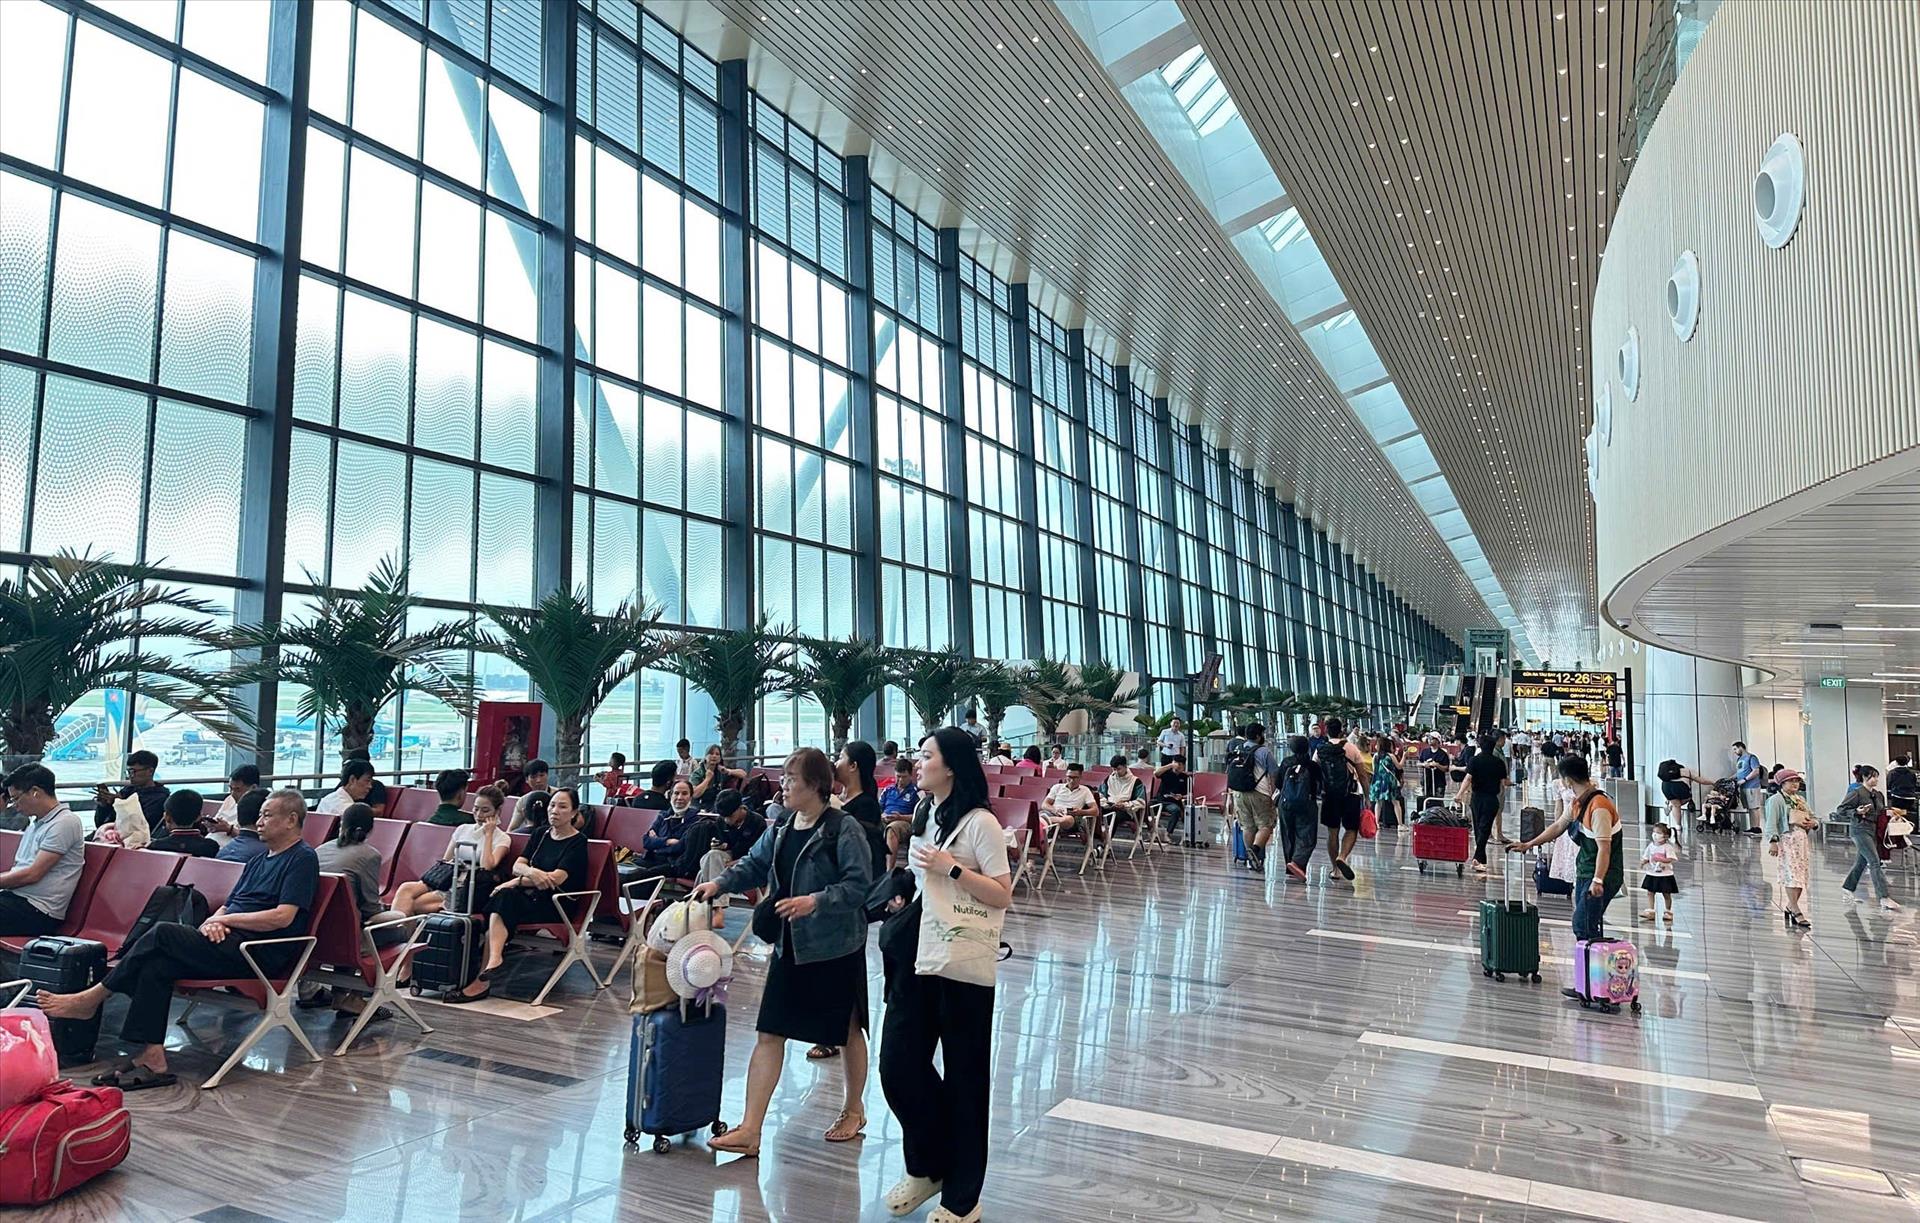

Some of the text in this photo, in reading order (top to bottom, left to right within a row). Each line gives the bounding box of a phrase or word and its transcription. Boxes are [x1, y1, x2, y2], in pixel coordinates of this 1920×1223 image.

[1556, 673, 1590, 684] 12-26
[1827, 678, 1843, 687] EXIT
[953, 905, 988, 918] Nutifood
